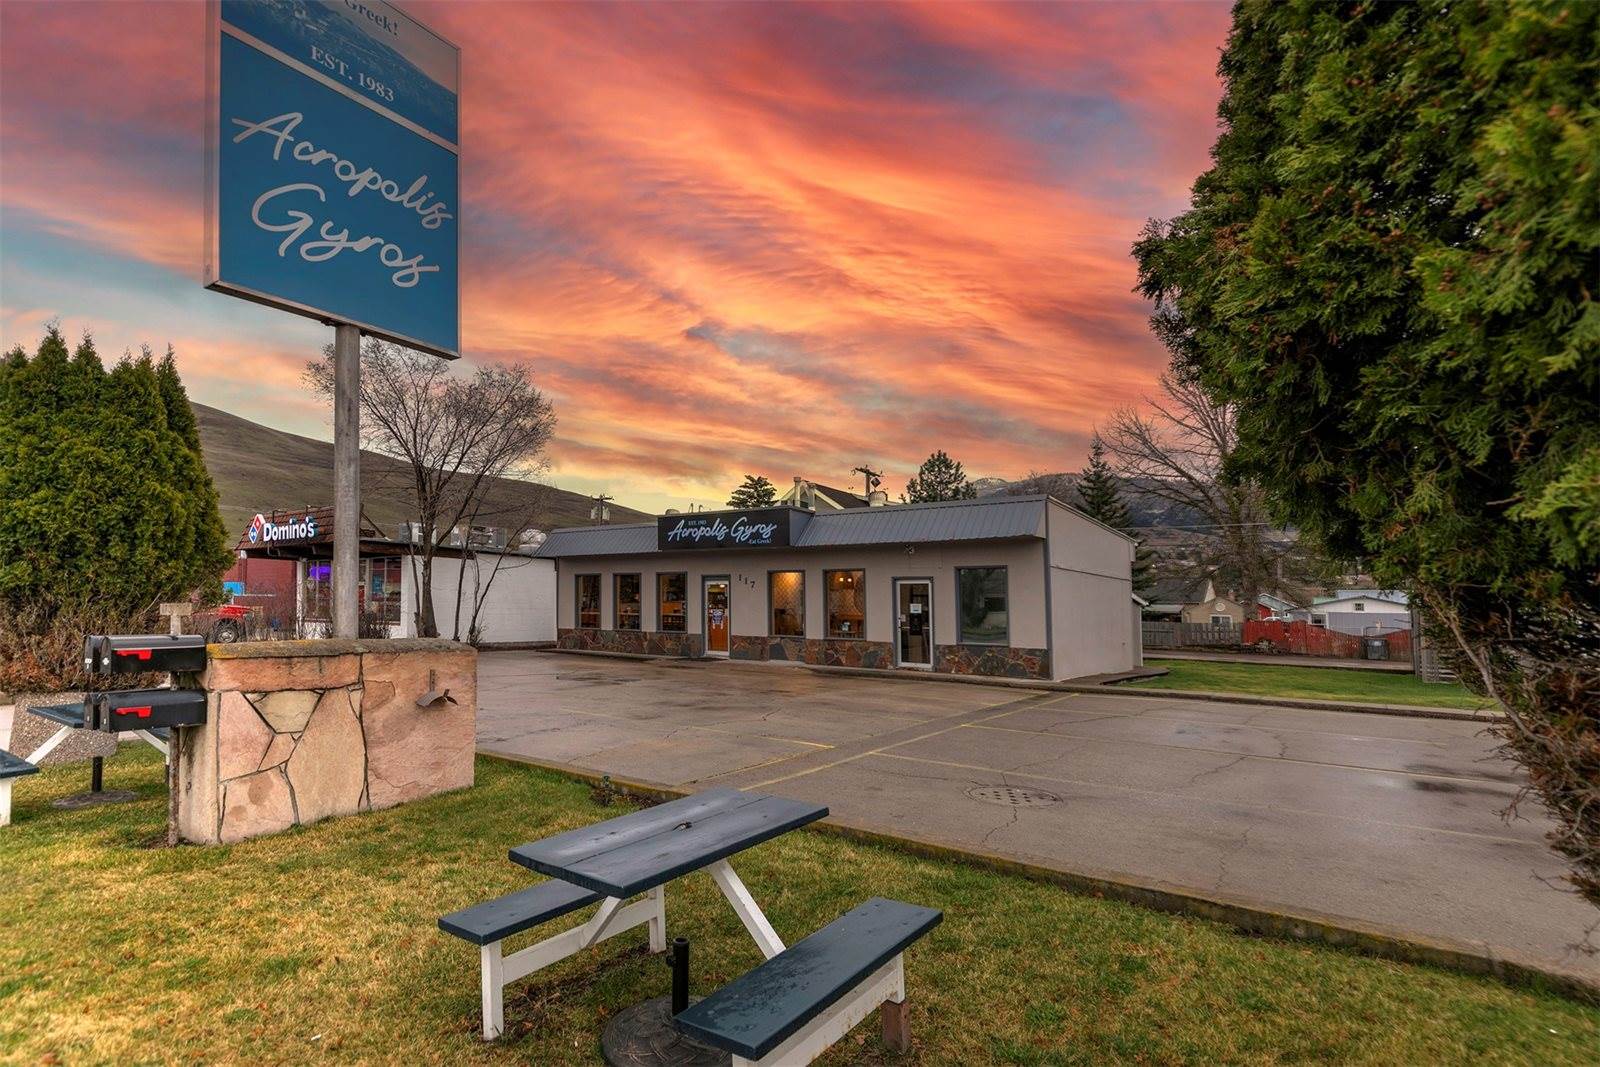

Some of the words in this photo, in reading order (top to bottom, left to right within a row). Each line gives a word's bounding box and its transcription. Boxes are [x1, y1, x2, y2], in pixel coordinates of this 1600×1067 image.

[310, 45, 353, 80] EST.
[359, 72, 395, 102] 1983
[231, 112, 453, 230] Acropolis
[251, 183, 440, 288] Gyros
[263, 516, 315, 542] Domino's
[667, 517, 730, 542] Acropolis
[730, 516, 778, 543] Gyros
[738, 573, 756, 589] 117
